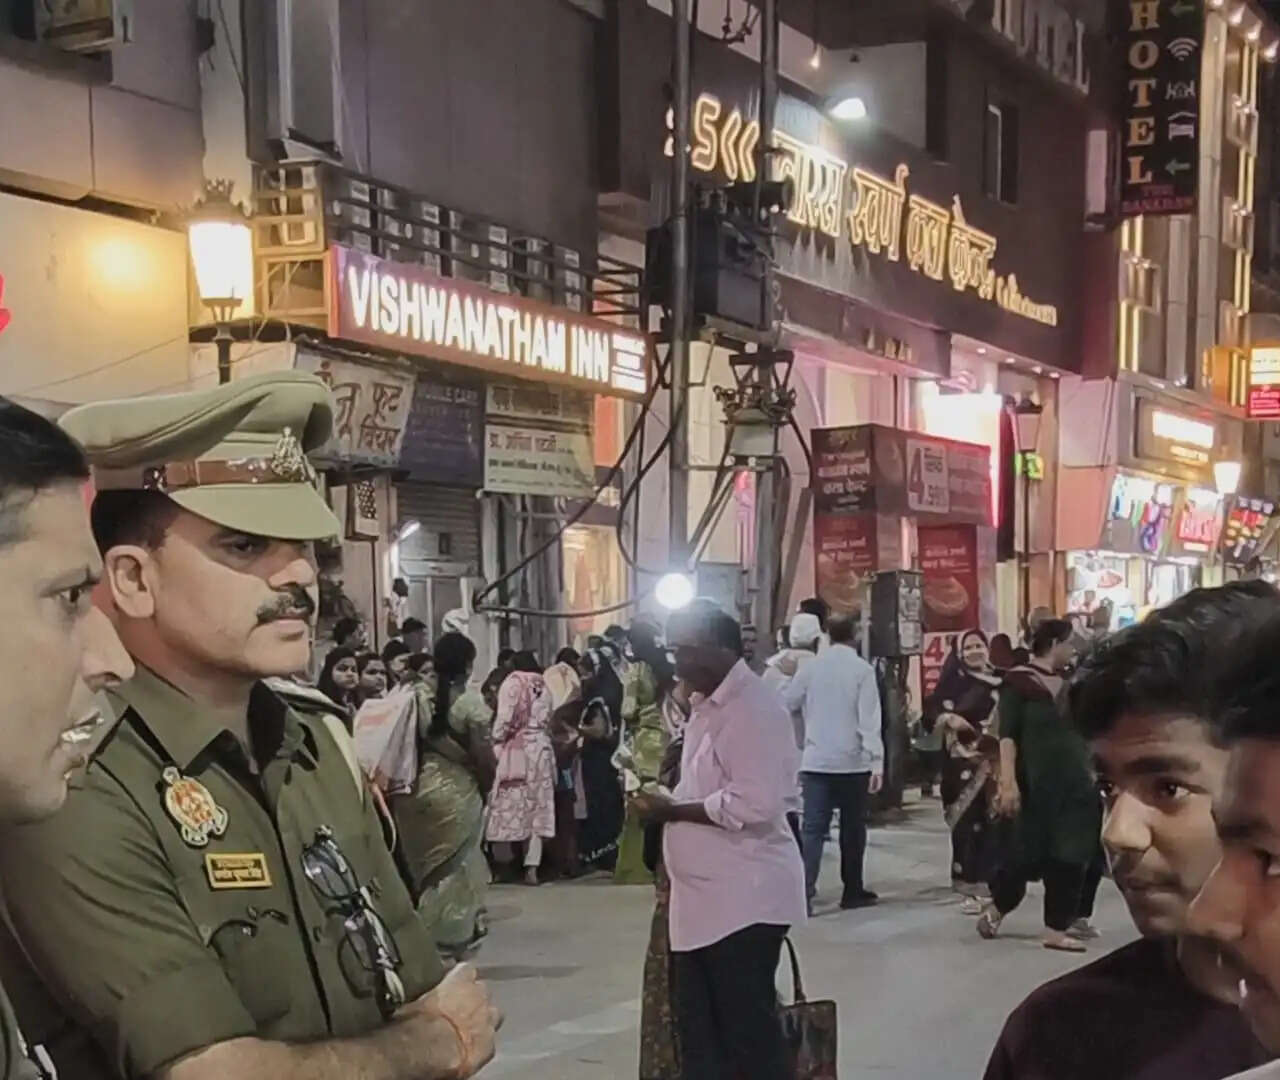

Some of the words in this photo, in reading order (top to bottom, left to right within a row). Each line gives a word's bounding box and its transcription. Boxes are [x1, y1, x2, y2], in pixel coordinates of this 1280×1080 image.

[1127, 0, 1161, 185] HOTEL
[346, 264, 567, 376] VISHWANATHAM
[569, 322, 610, 384] INN
